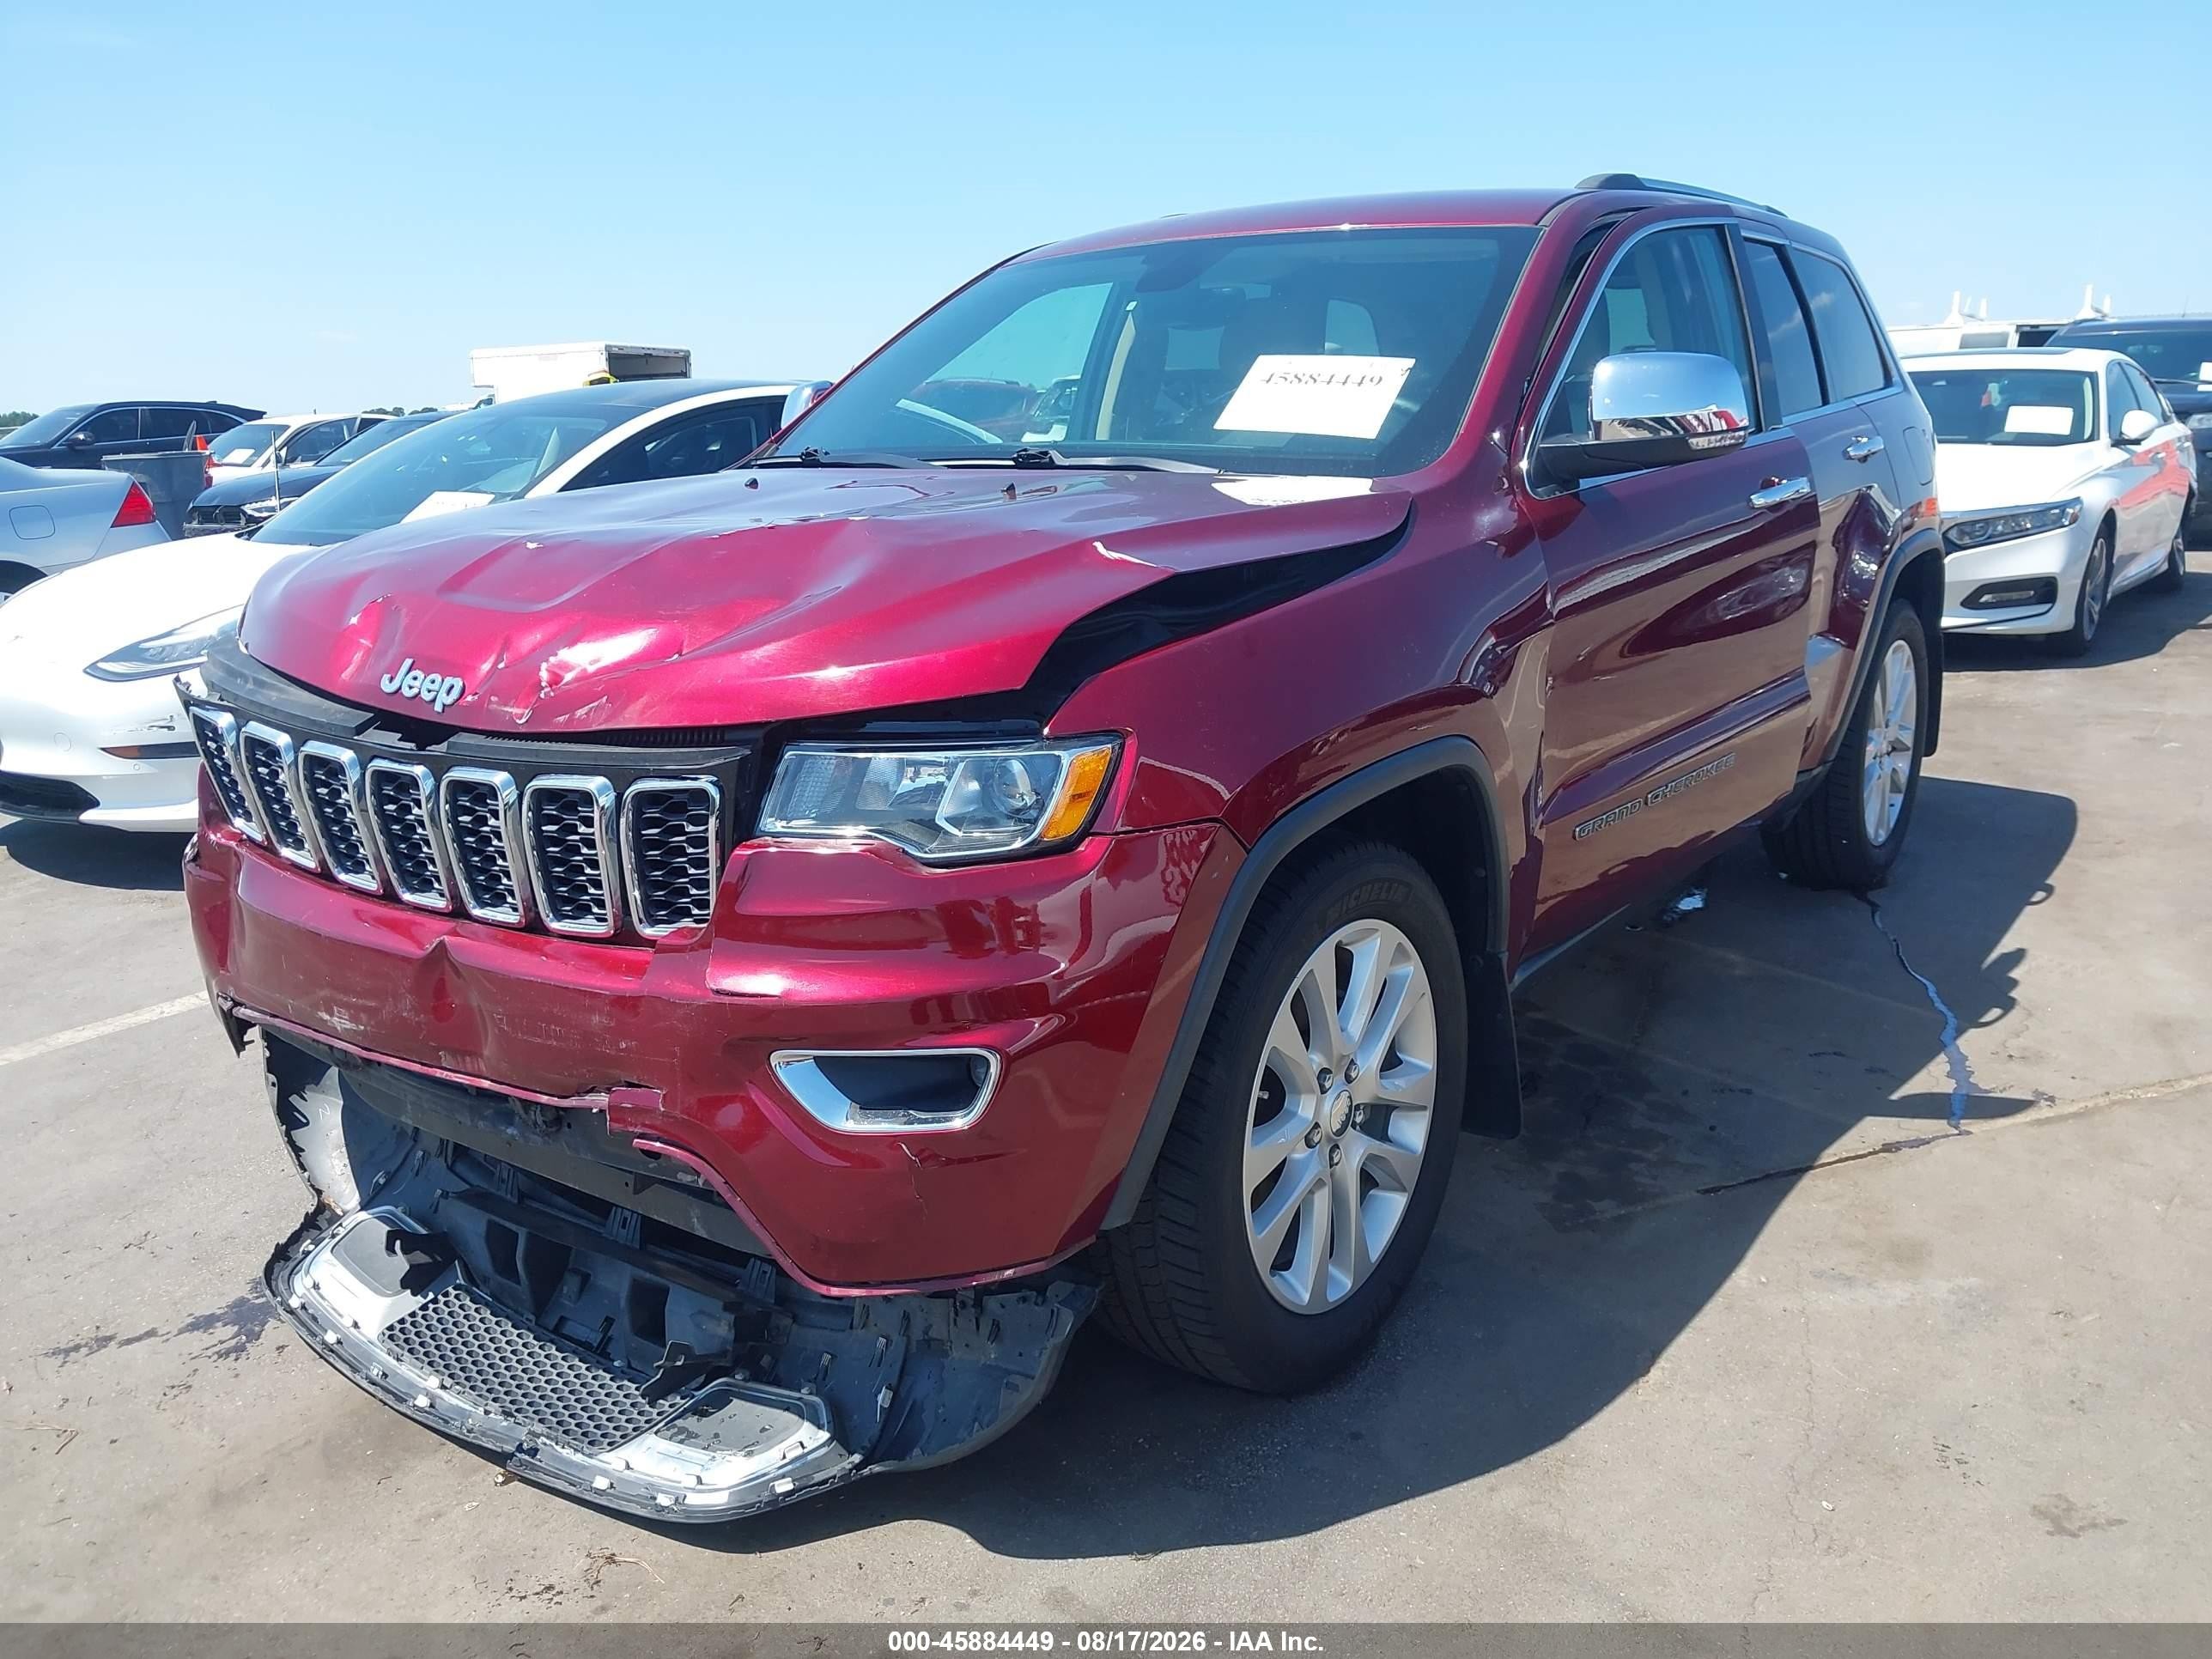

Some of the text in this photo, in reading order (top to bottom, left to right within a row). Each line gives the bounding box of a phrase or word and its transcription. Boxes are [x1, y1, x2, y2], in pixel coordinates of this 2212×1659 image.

[1260, 371, 1383, 387] 45884449
[380, 658, 465, 713] Jeep
[1573, 752, 1736, 841] GRAND CHEROKEE
